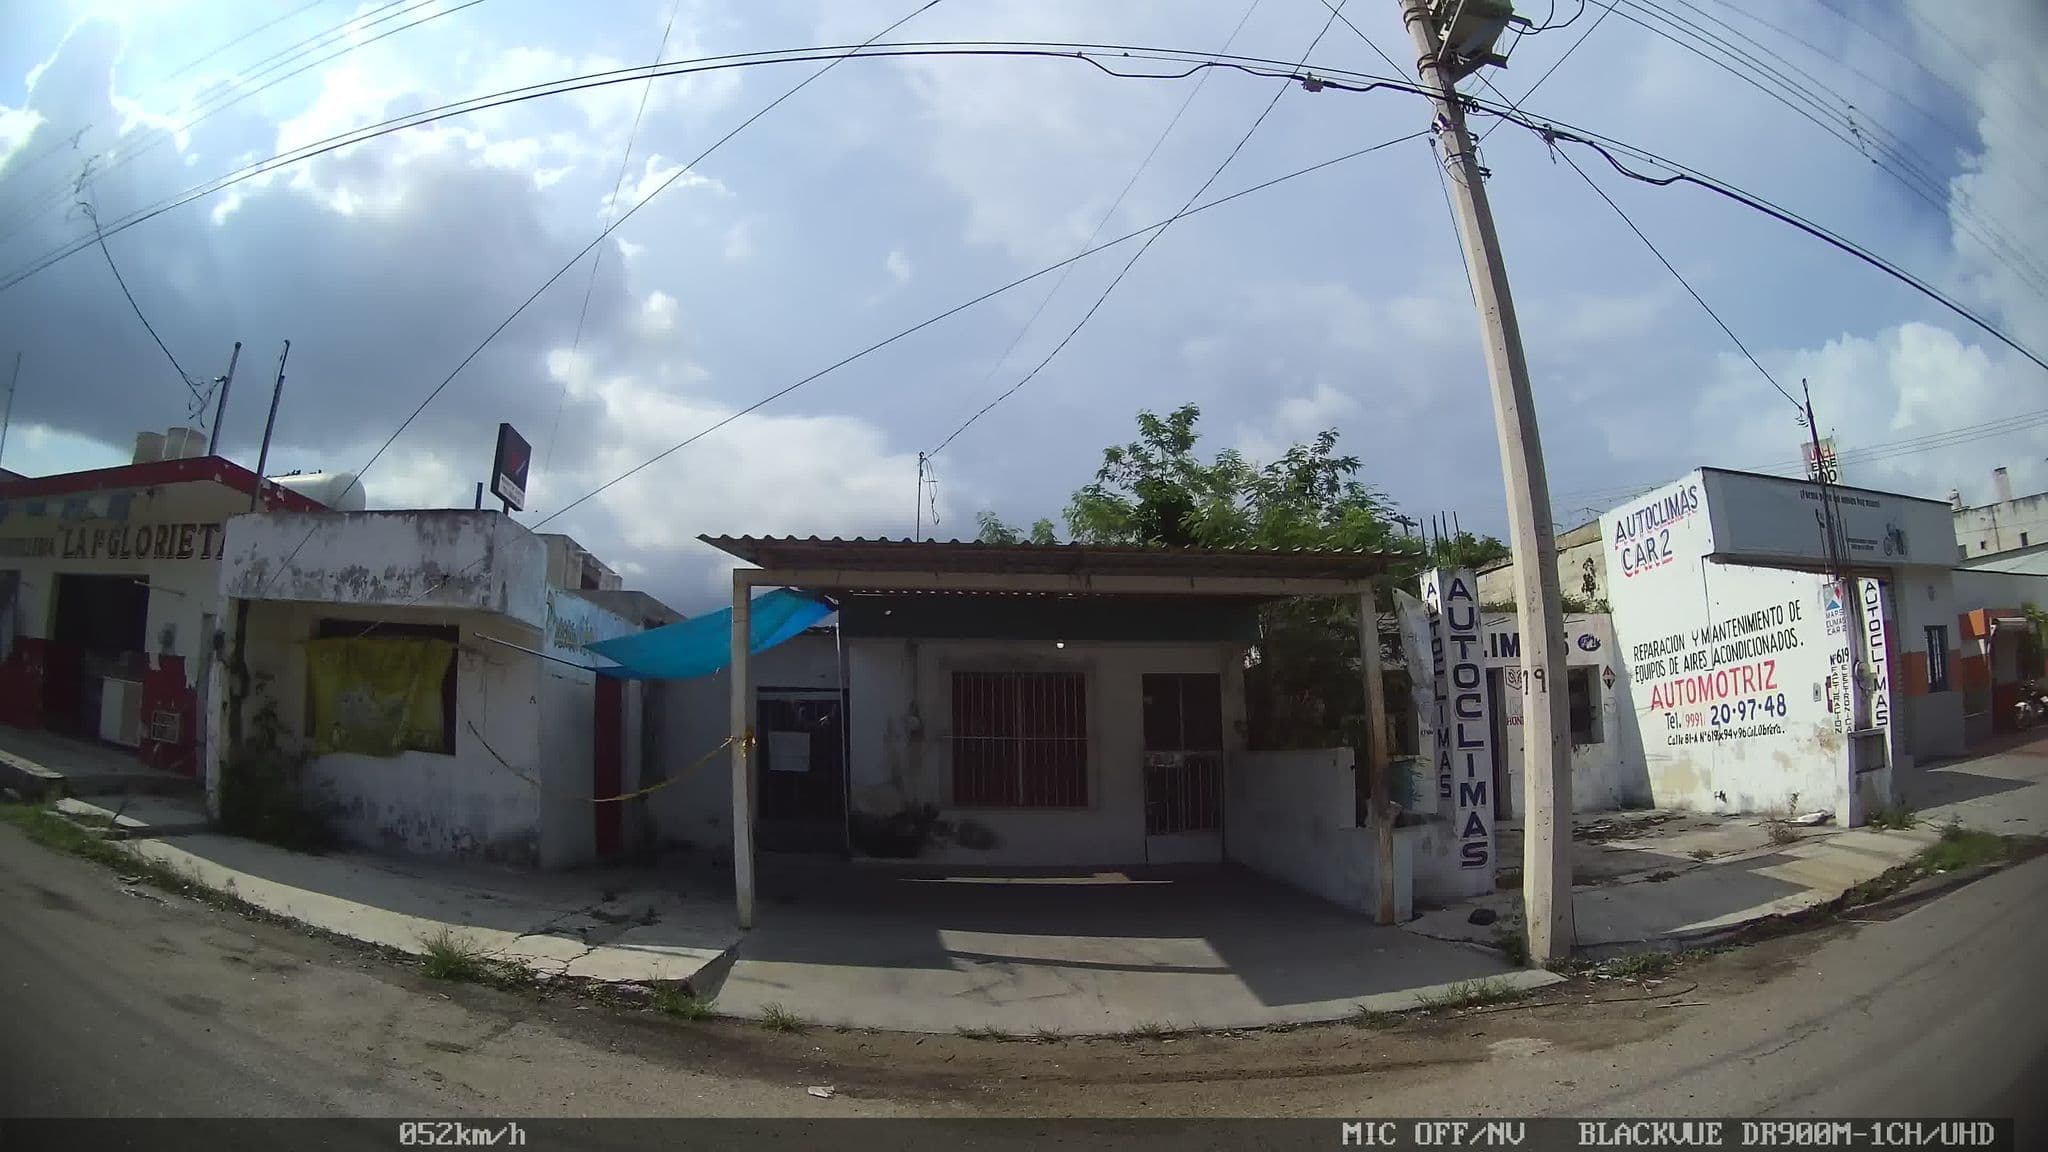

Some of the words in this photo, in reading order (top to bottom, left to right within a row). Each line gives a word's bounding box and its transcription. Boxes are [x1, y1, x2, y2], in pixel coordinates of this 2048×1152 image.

[107, 523, 224, 560] GLORIET
[1615, 485, 1699, 545] AUTOCLIMAS
[1622, 537, 1660, 572] CAR
[1660, 528, 1673, 558] 2
[1633, 632, 1686, 662] REPARACION
[1691, 629, 1699, 647] Y
[1701, 604, 1784, 645] MANTENIMIENTO
[1788, 599, 1802, 622] DE
[1635, 660, 1666, 685] EQUIPOS
[1669, 656, 1680, 675] DE
[1684, 650, 1708, 672] AIRES
[1713, 627, 1804, 667] ACONDICIONADOS.
[1864, 581, 1889, 727] AUTOCLIMAS
[1651, 660, 1778, 711] AUTOMOTRIZ
[1447, 577, 1489, 870] AUTOCLIMAS
[1665, 712, 1681, 730] Tel.
[1668, 734, 1684, 745] Calle
